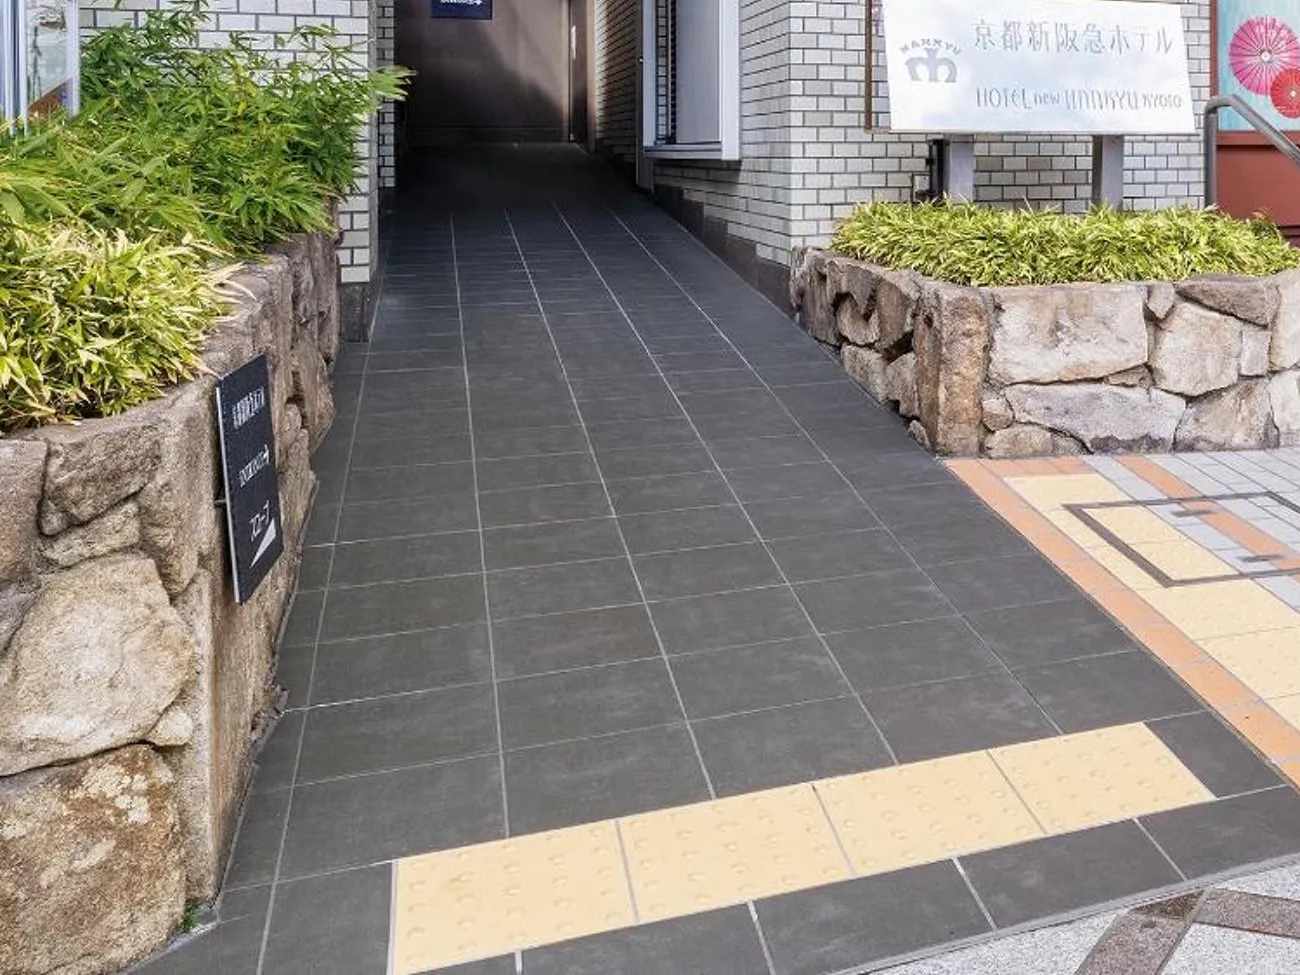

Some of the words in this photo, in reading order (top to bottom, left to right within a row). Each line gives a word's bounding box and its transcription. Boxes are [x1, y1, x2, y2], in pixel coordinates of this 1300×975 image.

[972, 18, 1174, 56] 京都新阪急ホテル
[976, 87, 1032, 110] HOTEL
[1034, 92, 1061, 107] new
